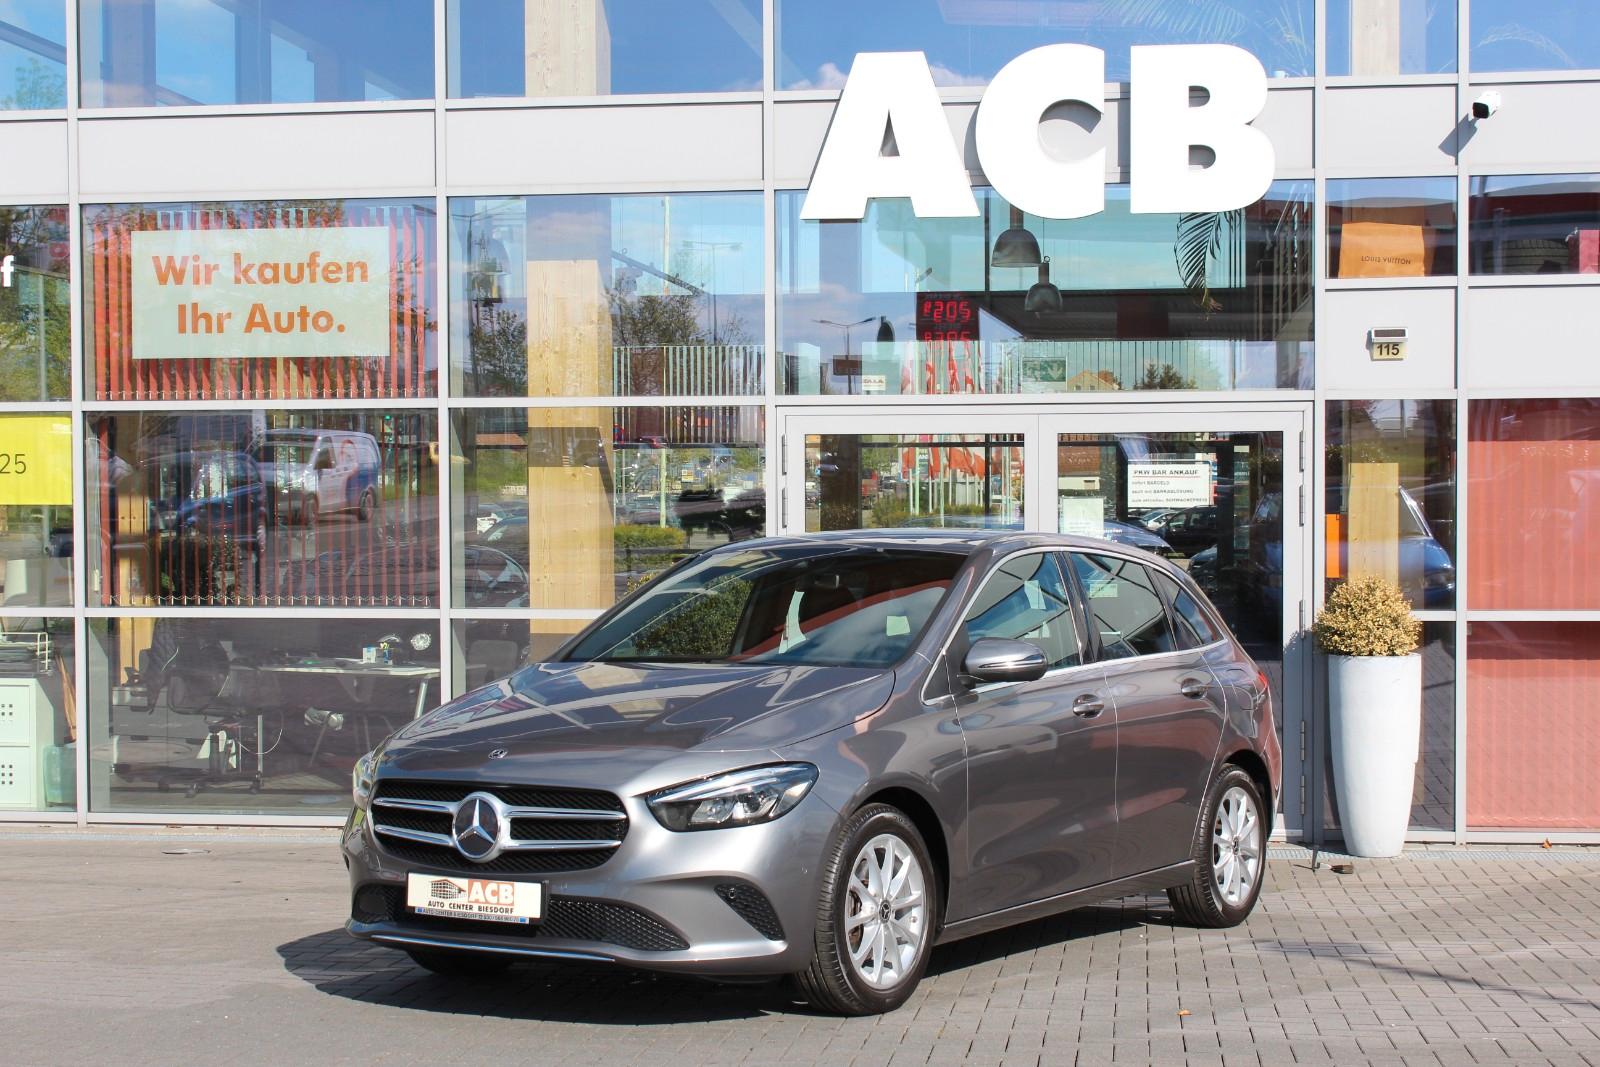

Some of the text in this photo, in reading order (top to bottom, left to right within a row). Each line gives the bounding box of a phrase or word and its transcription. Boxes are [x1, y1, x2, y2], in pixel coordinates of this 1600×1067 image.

[800, 43, 1276, 220] ACB
[153, 251, 369, 286] Wir kaufen
[178, 303, 346, 334] Ihr Auto.
[1377, 343, 1400, 356] 115
[0, 453, 27, 475] 25
[469, 881, 514, 905] ACB
[428, 900, 514, 915] AUTO CENTER BIESDORF
